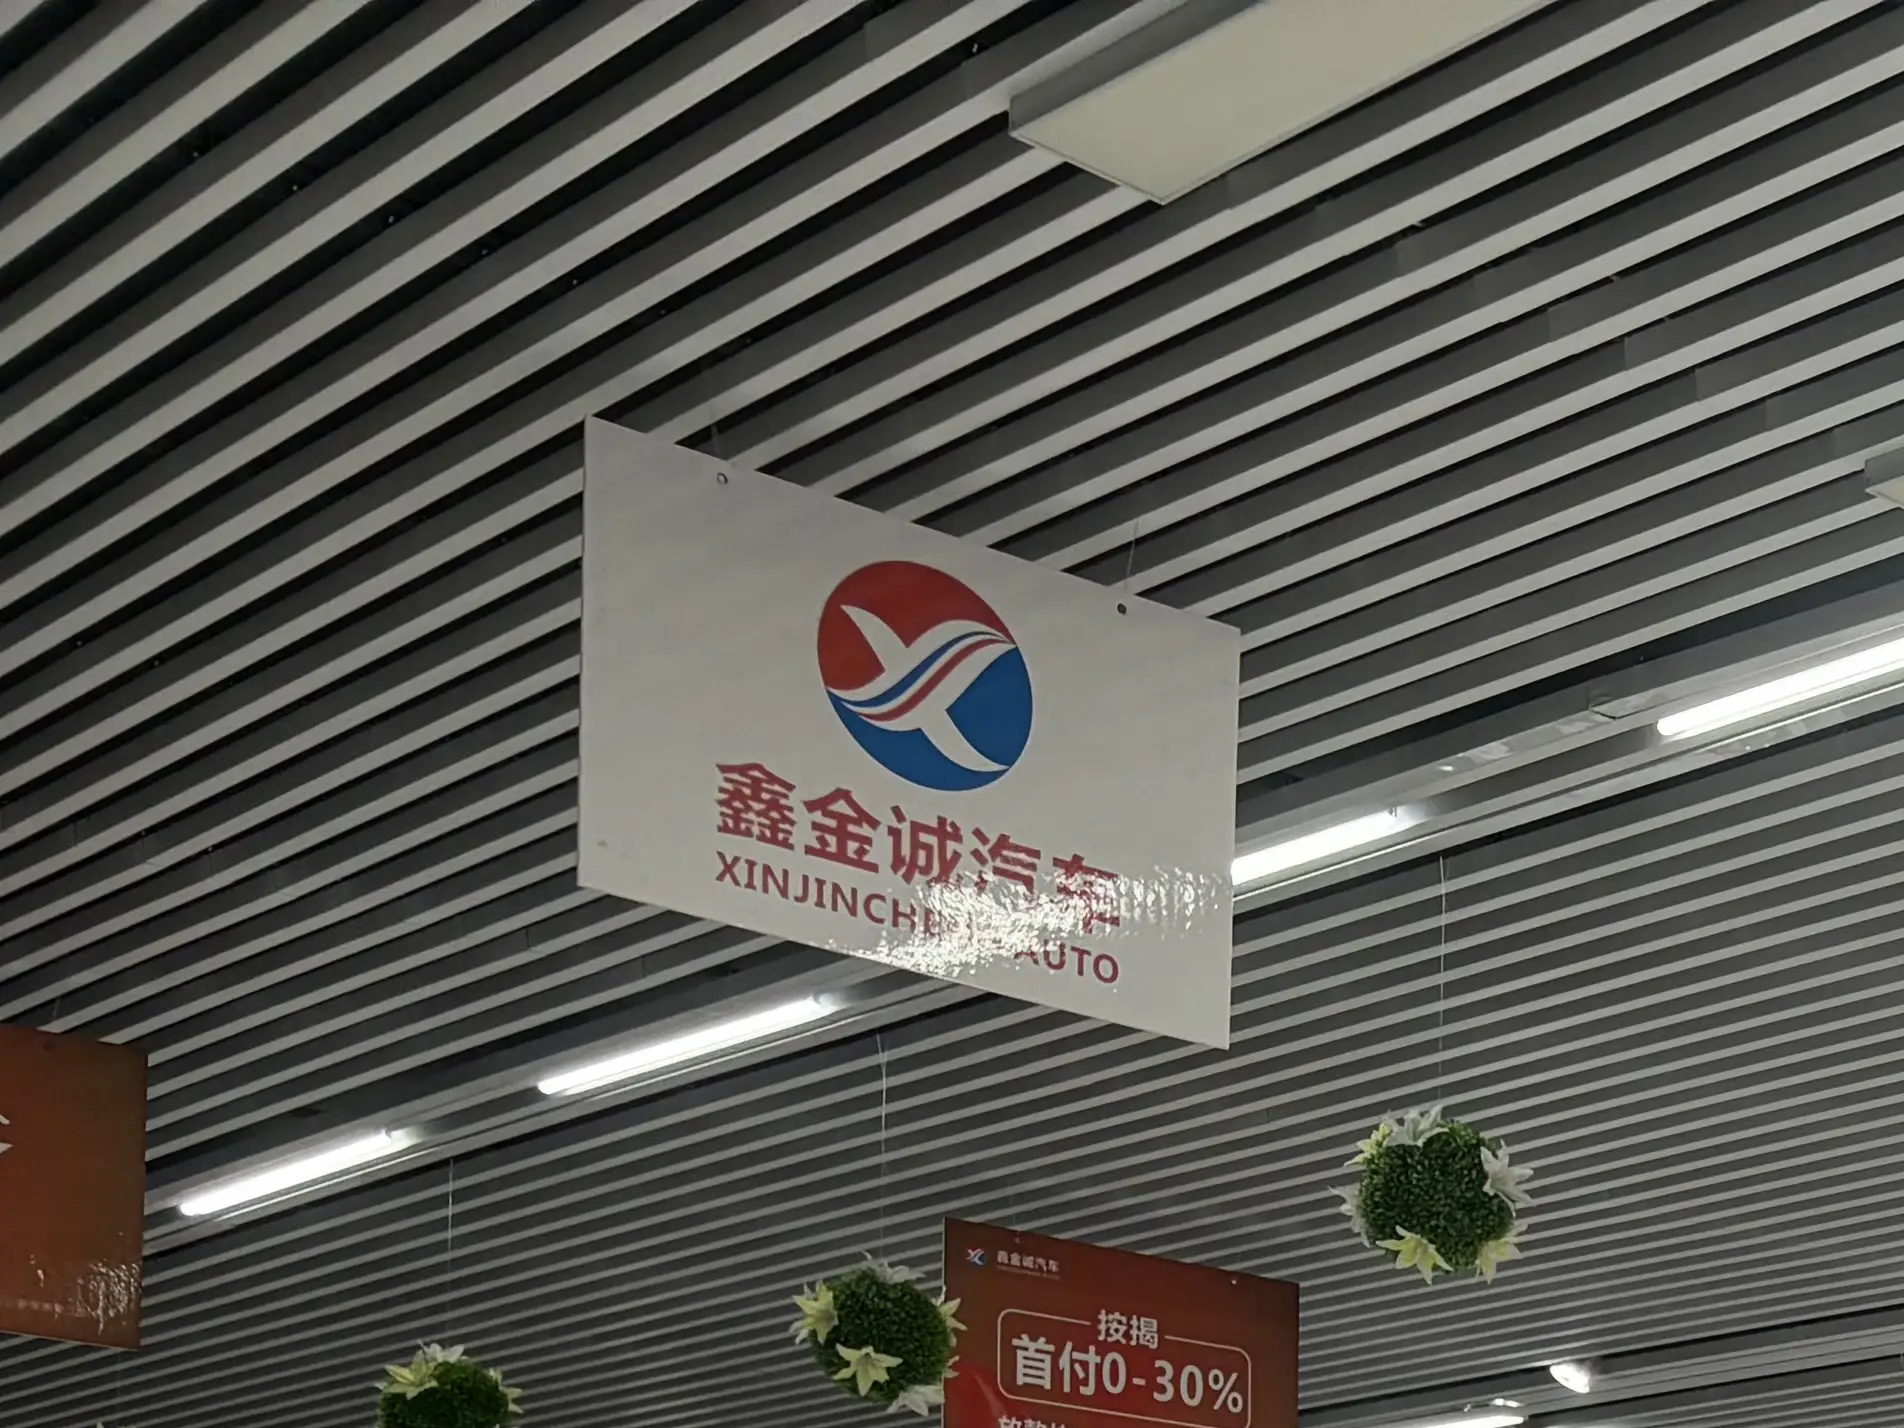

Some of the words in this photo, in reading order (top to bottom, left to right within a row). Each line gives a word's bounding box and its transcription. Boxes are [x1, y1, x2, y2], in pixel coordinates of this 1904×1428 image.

[715, 762, 1120, 933] 鑫金诚汽车
[1097, 1309, 1159, 1349] 按揭
[1012, 1334, 1244, 1414] 首付0-30%
